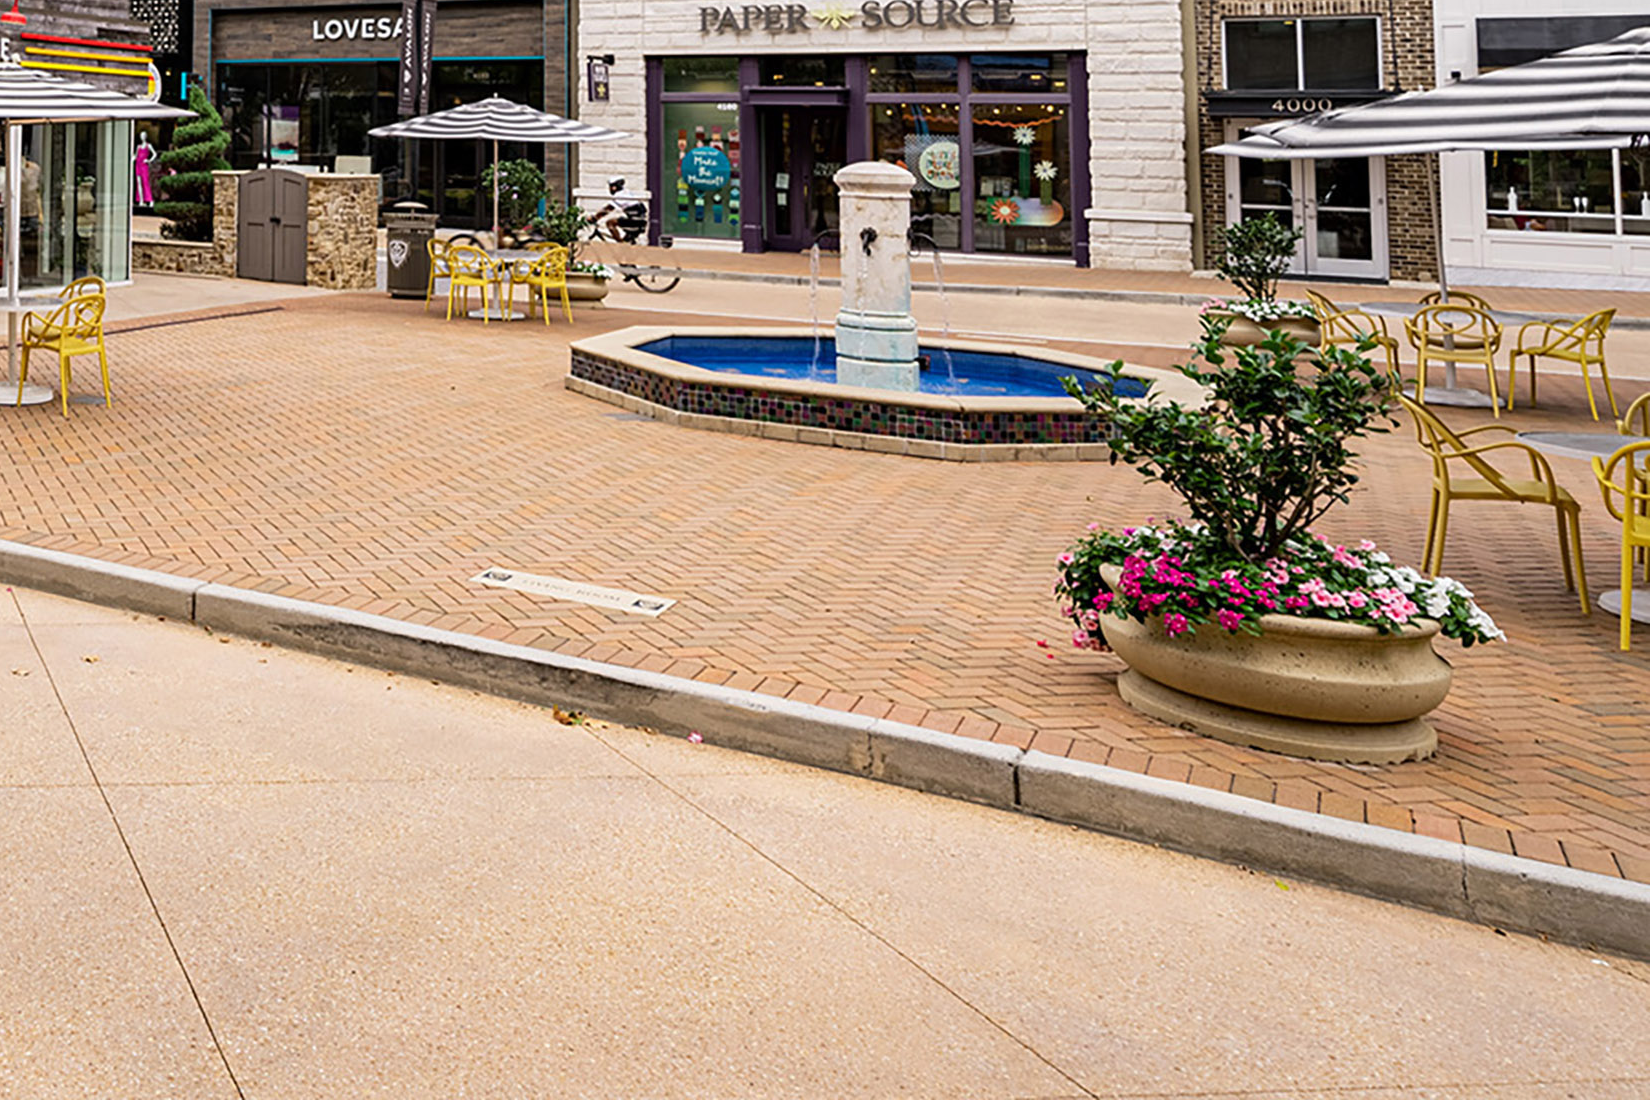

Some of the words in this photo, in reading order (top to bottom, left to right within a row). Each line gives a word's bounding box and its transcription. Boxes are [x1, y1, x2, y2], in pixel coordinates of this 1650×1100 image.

[312, 17, 403, 40] LOVESA
[700, 3, 810, 34] PAPER
[1271, 98, 1333, 113] 4000
